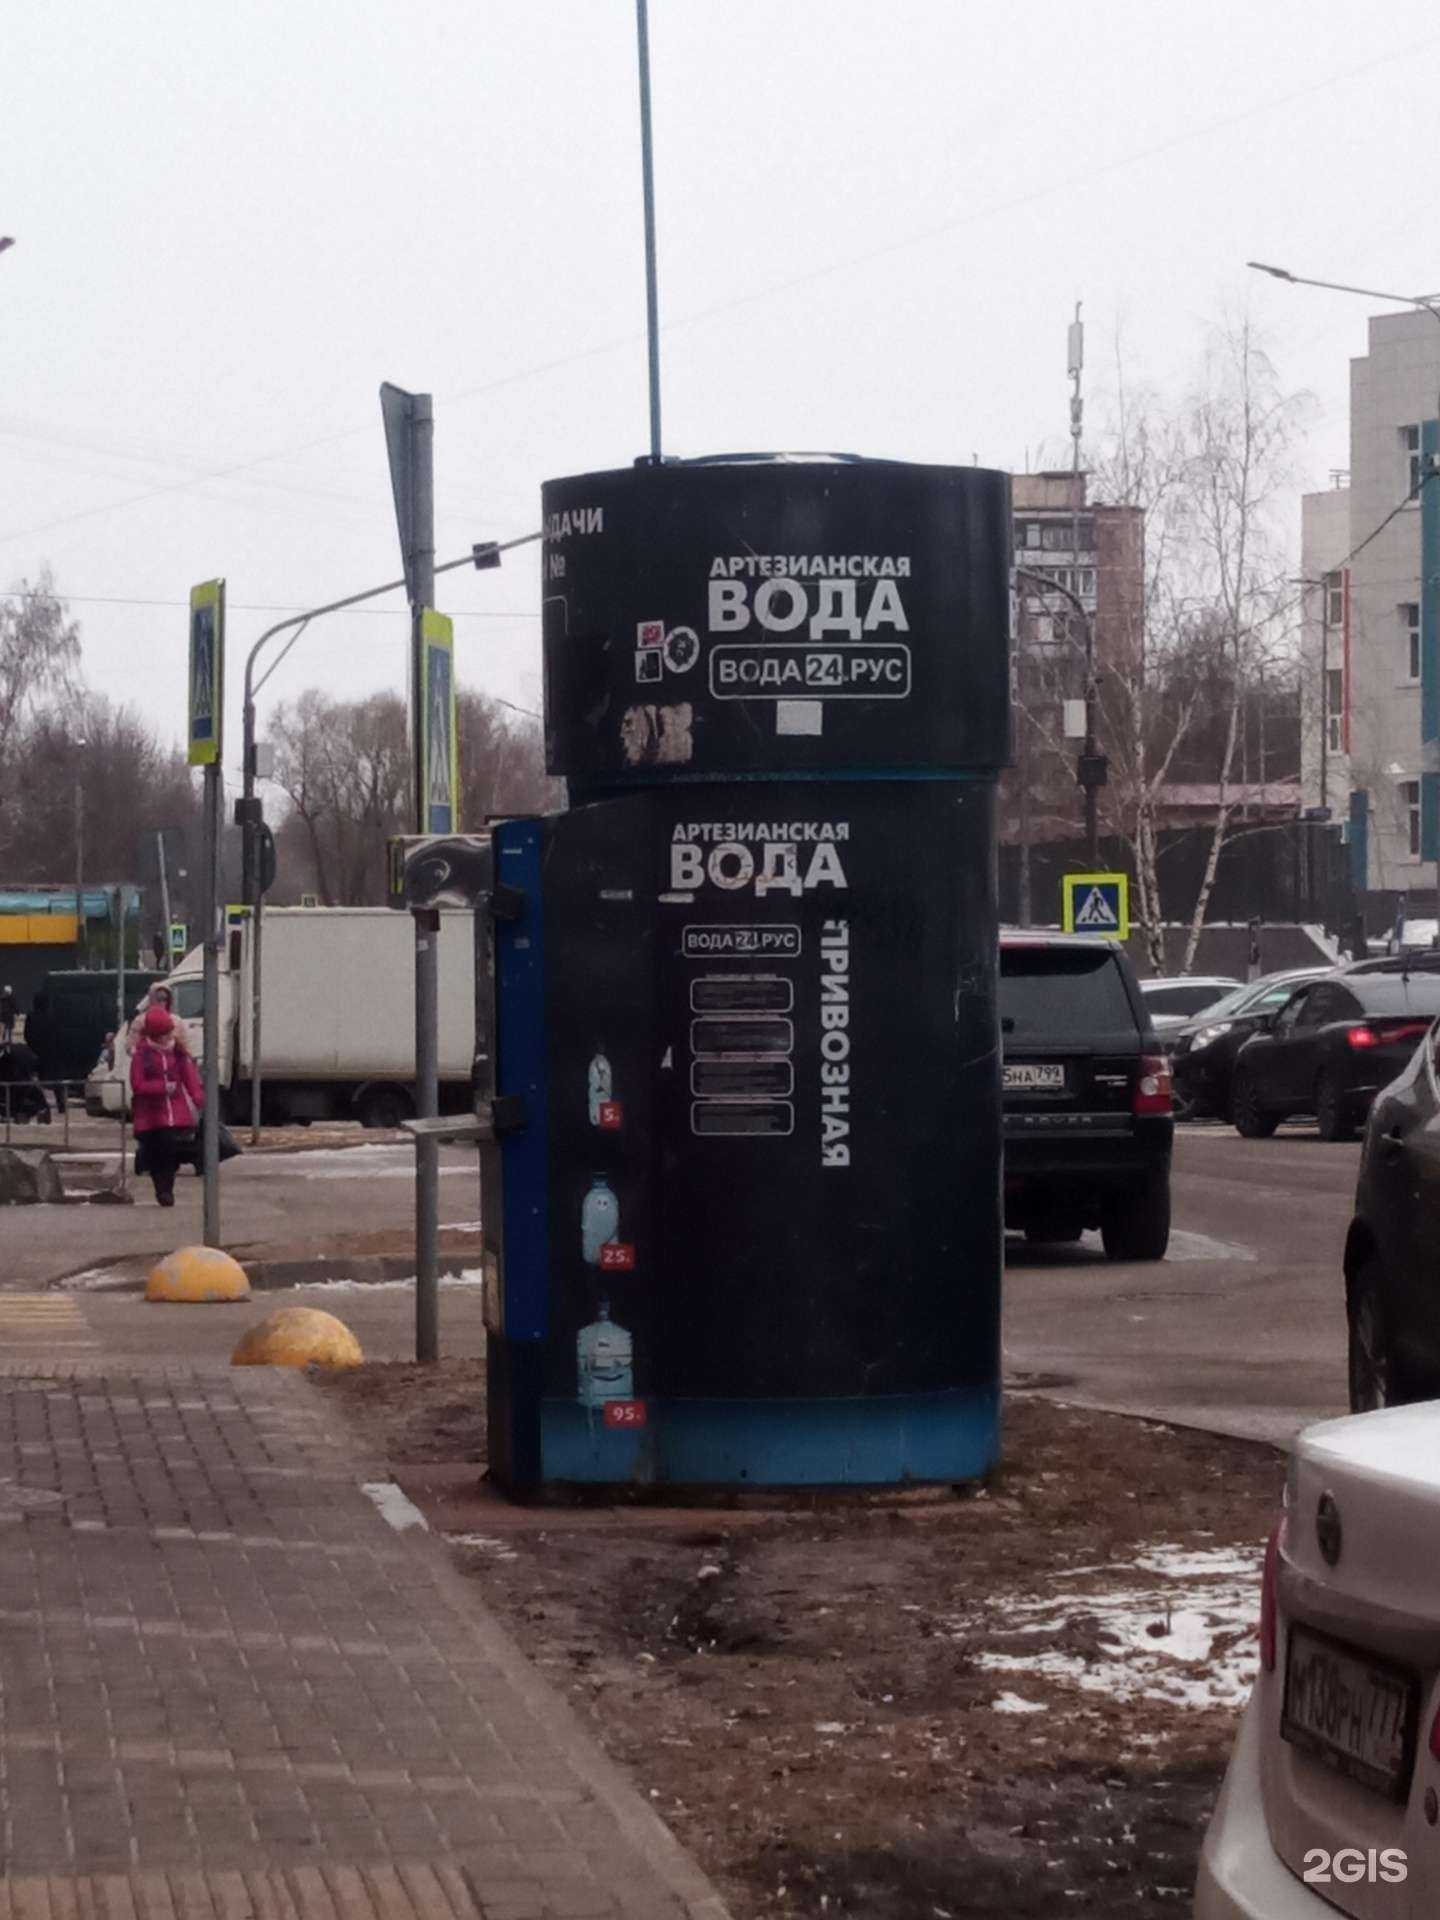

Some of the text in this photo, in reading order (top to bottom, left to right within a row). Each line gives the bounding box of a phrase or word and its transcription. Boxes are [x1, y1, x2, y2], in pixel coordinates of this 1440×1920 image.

[710, 556, 911, 578] АРТЕЗИАНСКАЯ
[708, 579, 910, 640] ВОДА
[672, 822, 849, 842] АРТЕЗИАНСКАЯ
[670, 843, 847, 897] ВОДА
[821, 920, 850, 1166] ПРИВОЗНАЯ
